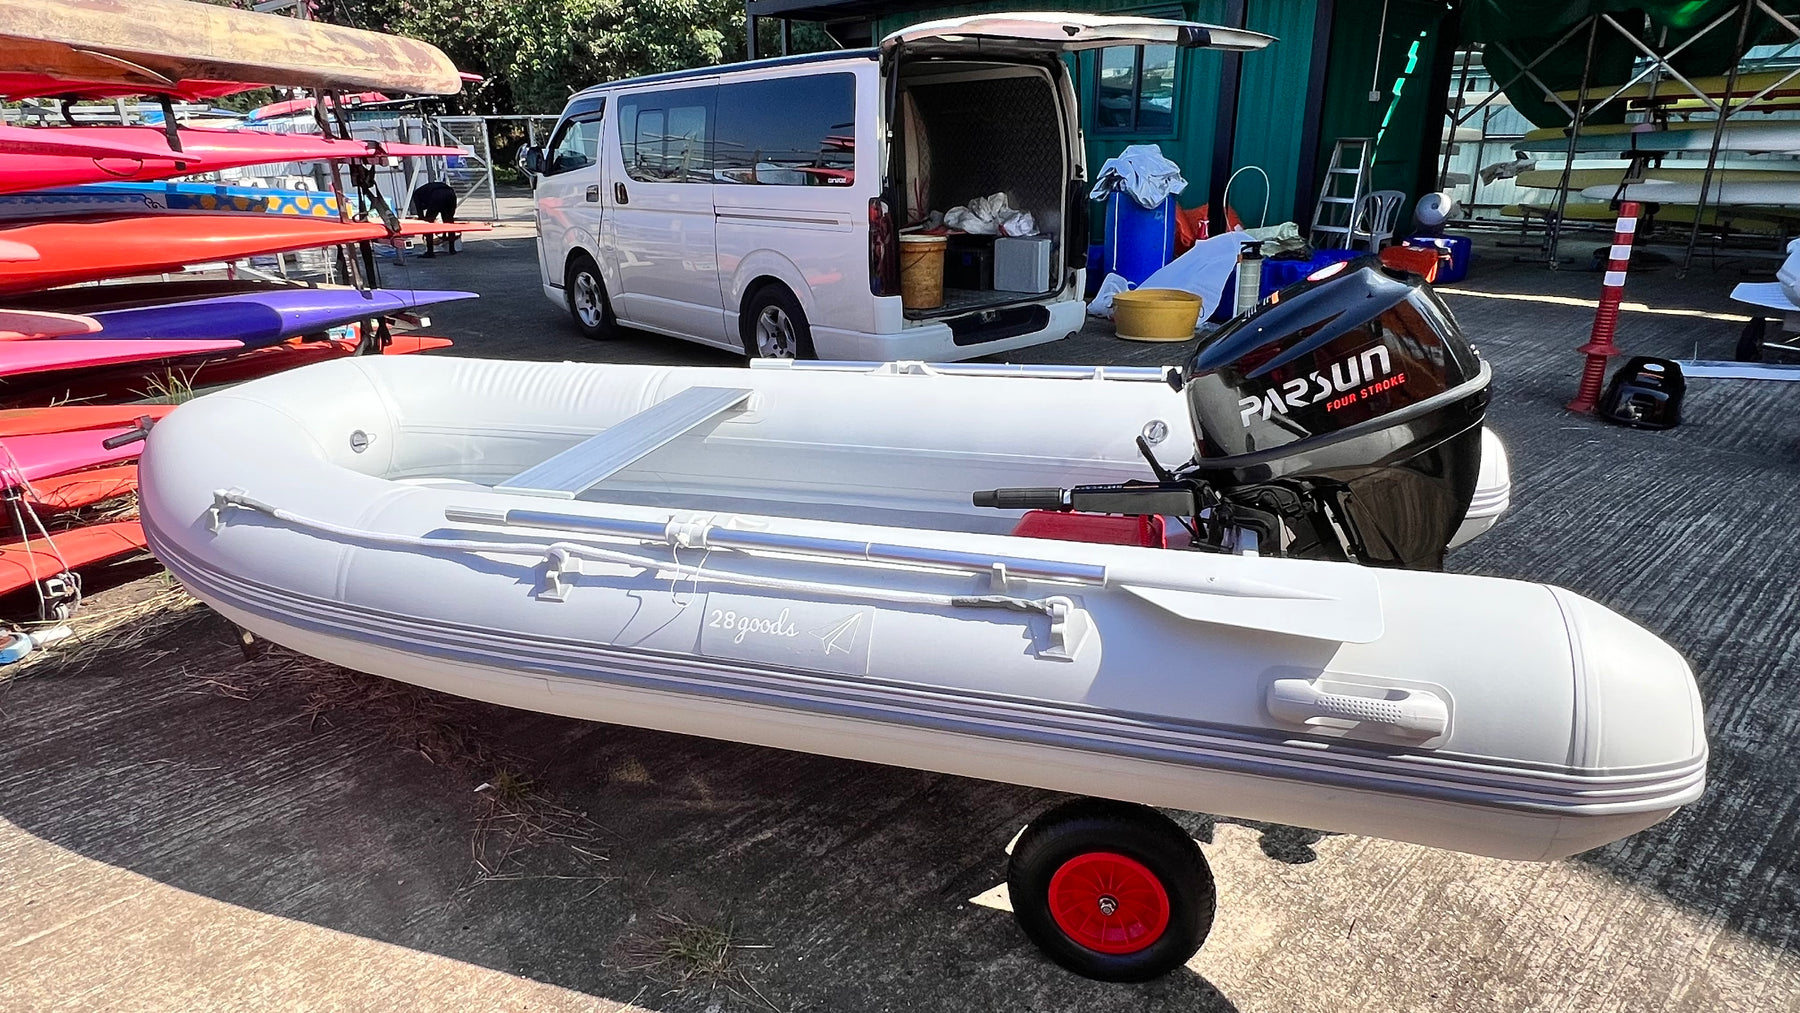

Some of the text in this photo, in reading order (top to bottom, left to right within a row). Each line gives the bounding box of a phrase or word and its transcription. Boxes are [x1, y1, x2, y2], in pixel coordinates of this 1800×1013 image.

[1238, 344, 1391, 428] PARSUN
[1326, 373, 1406, 412] FOUR STROKE
